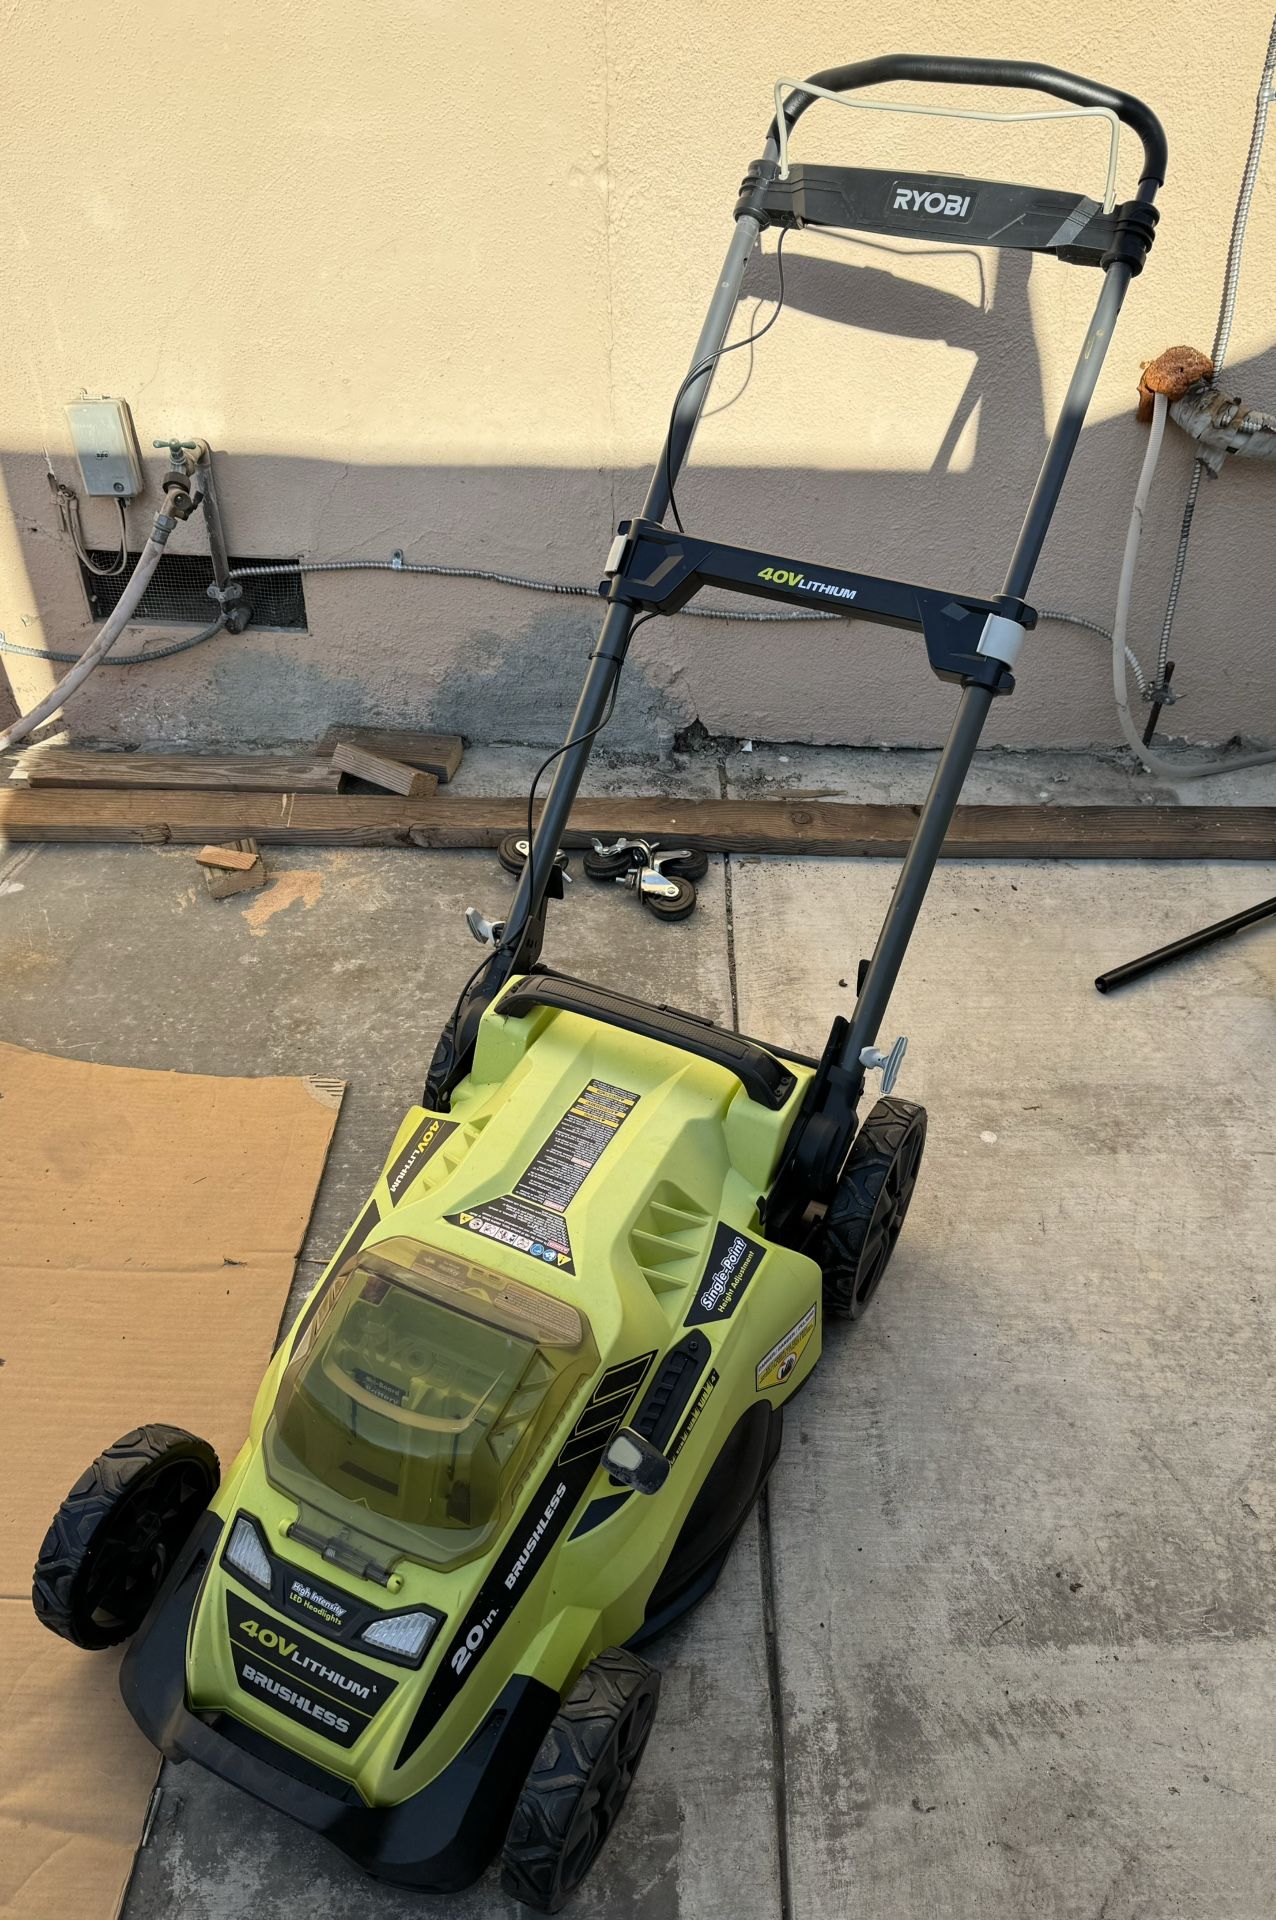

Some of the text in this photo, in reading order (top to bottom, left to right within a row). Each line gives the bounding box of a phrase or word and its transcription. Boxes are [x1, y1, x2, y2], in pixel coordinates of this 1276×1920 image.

[893, 188, 971, 217] RYOBI
[798, 579, 857, 600] LITHIUM
[701, 1237, 747, 1310] Single-Point
[718, 1250, 755, 1313] Height Adjustment
[504, 1482, 567, 1590] BRUSHLESS
[290, 1592, 342, 1625] LED Headlights
[291, 1581, 347, 1617] High Intensity
[242, 1664, 350, 1733] BRUSHLESS
[291, 1652, 370, 1699] LITHIUM
